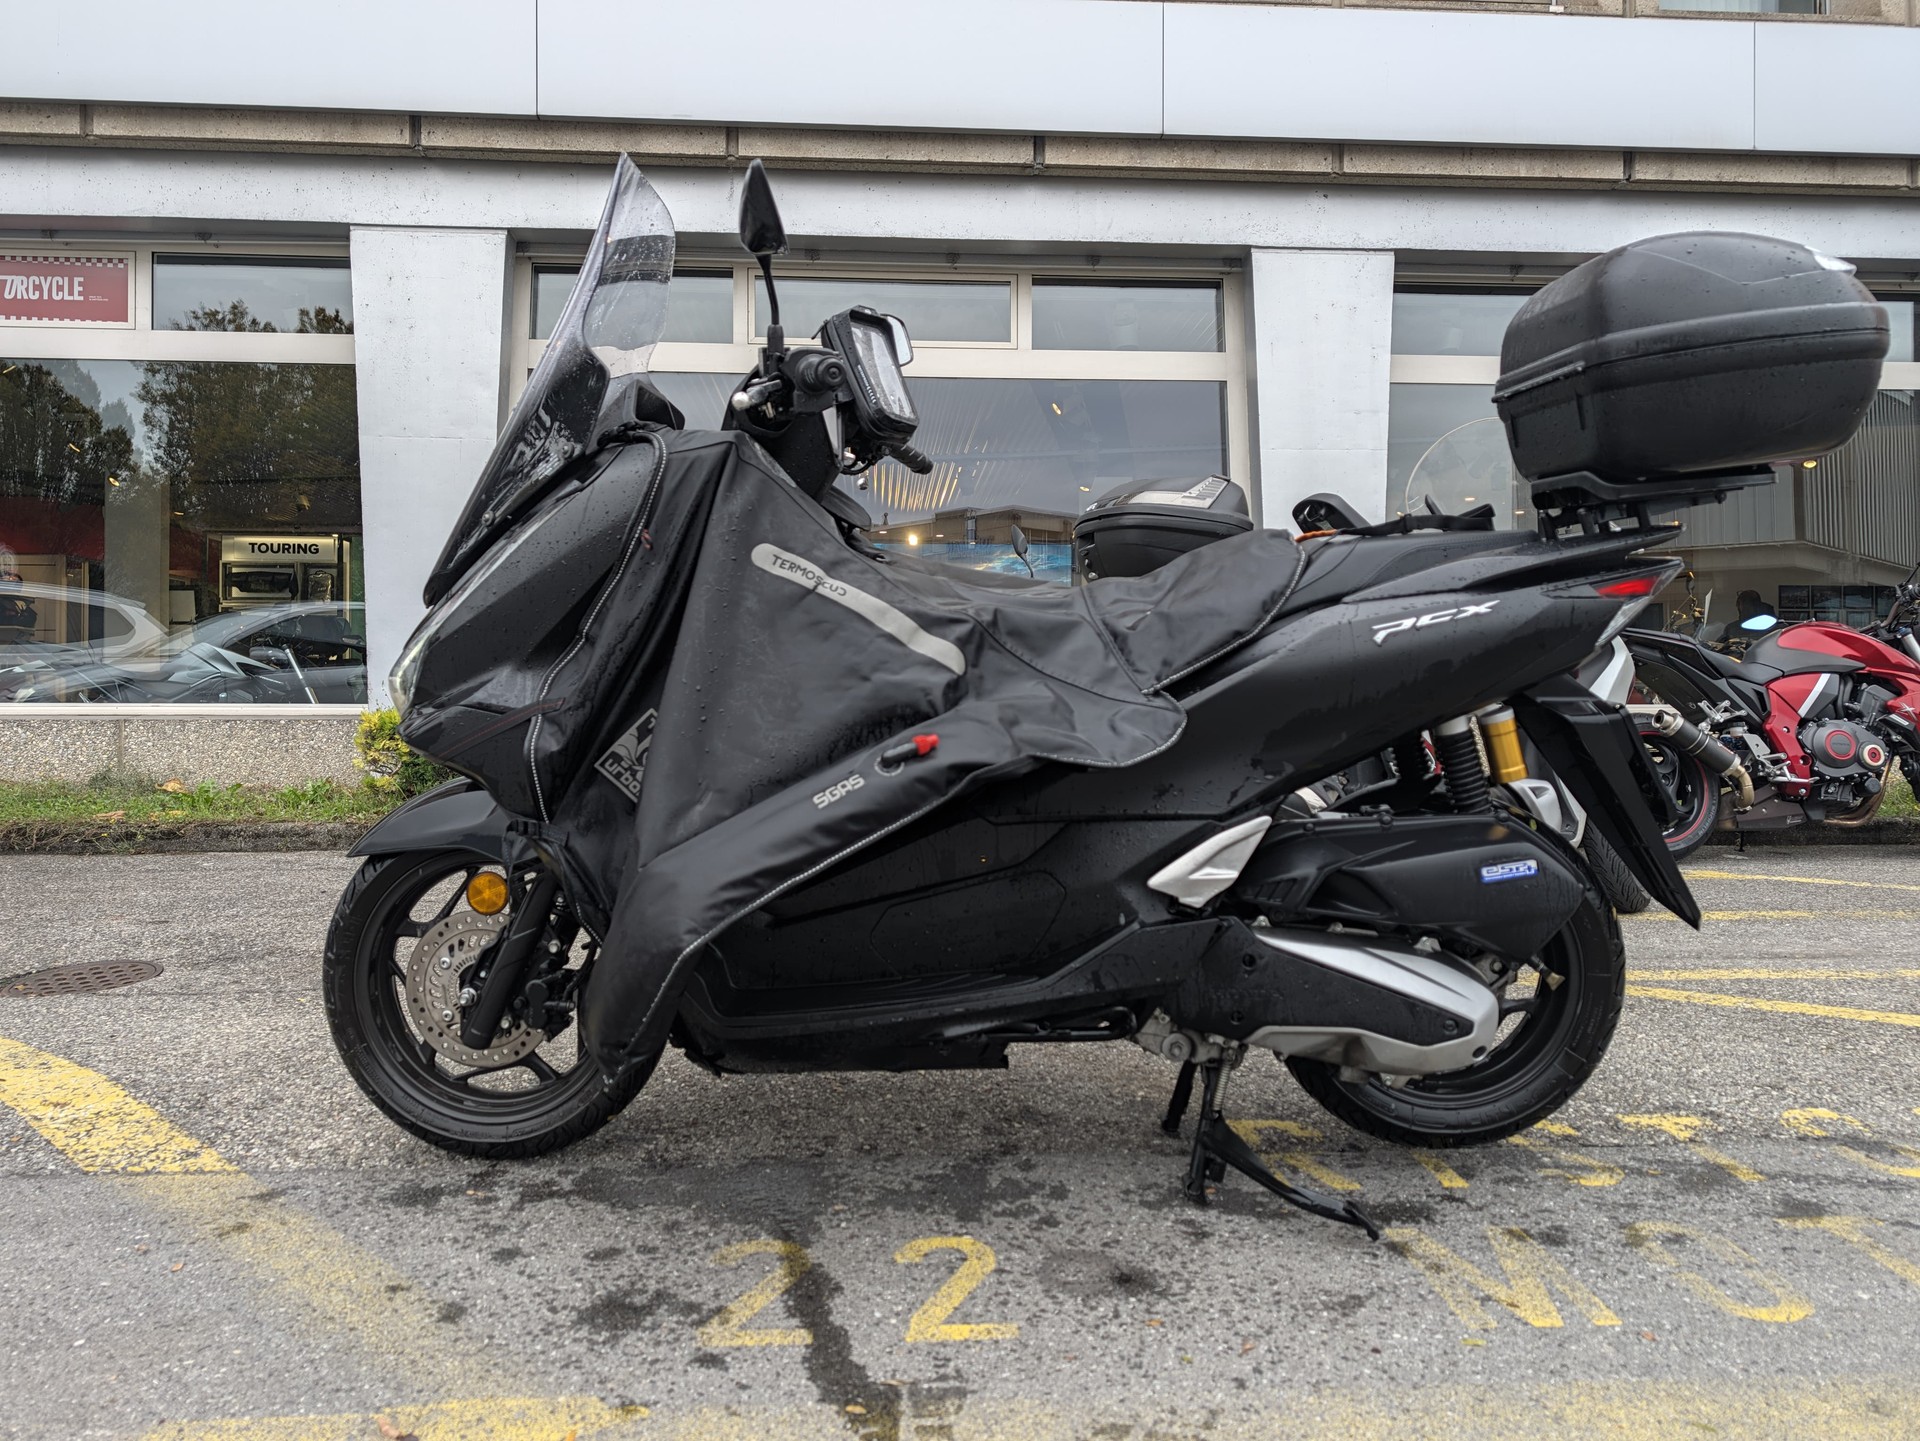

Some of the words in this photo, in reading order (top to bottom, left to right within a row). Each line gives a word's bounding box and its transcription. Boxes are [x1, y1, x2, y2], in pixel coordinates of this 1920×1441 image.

[0, 275, 84, 301] ORCYCLE
[248, 542, 320, 555] TOURING
[1371, 600, 1500, 645] PCX
[812, 773, 865, 809] SGAS
